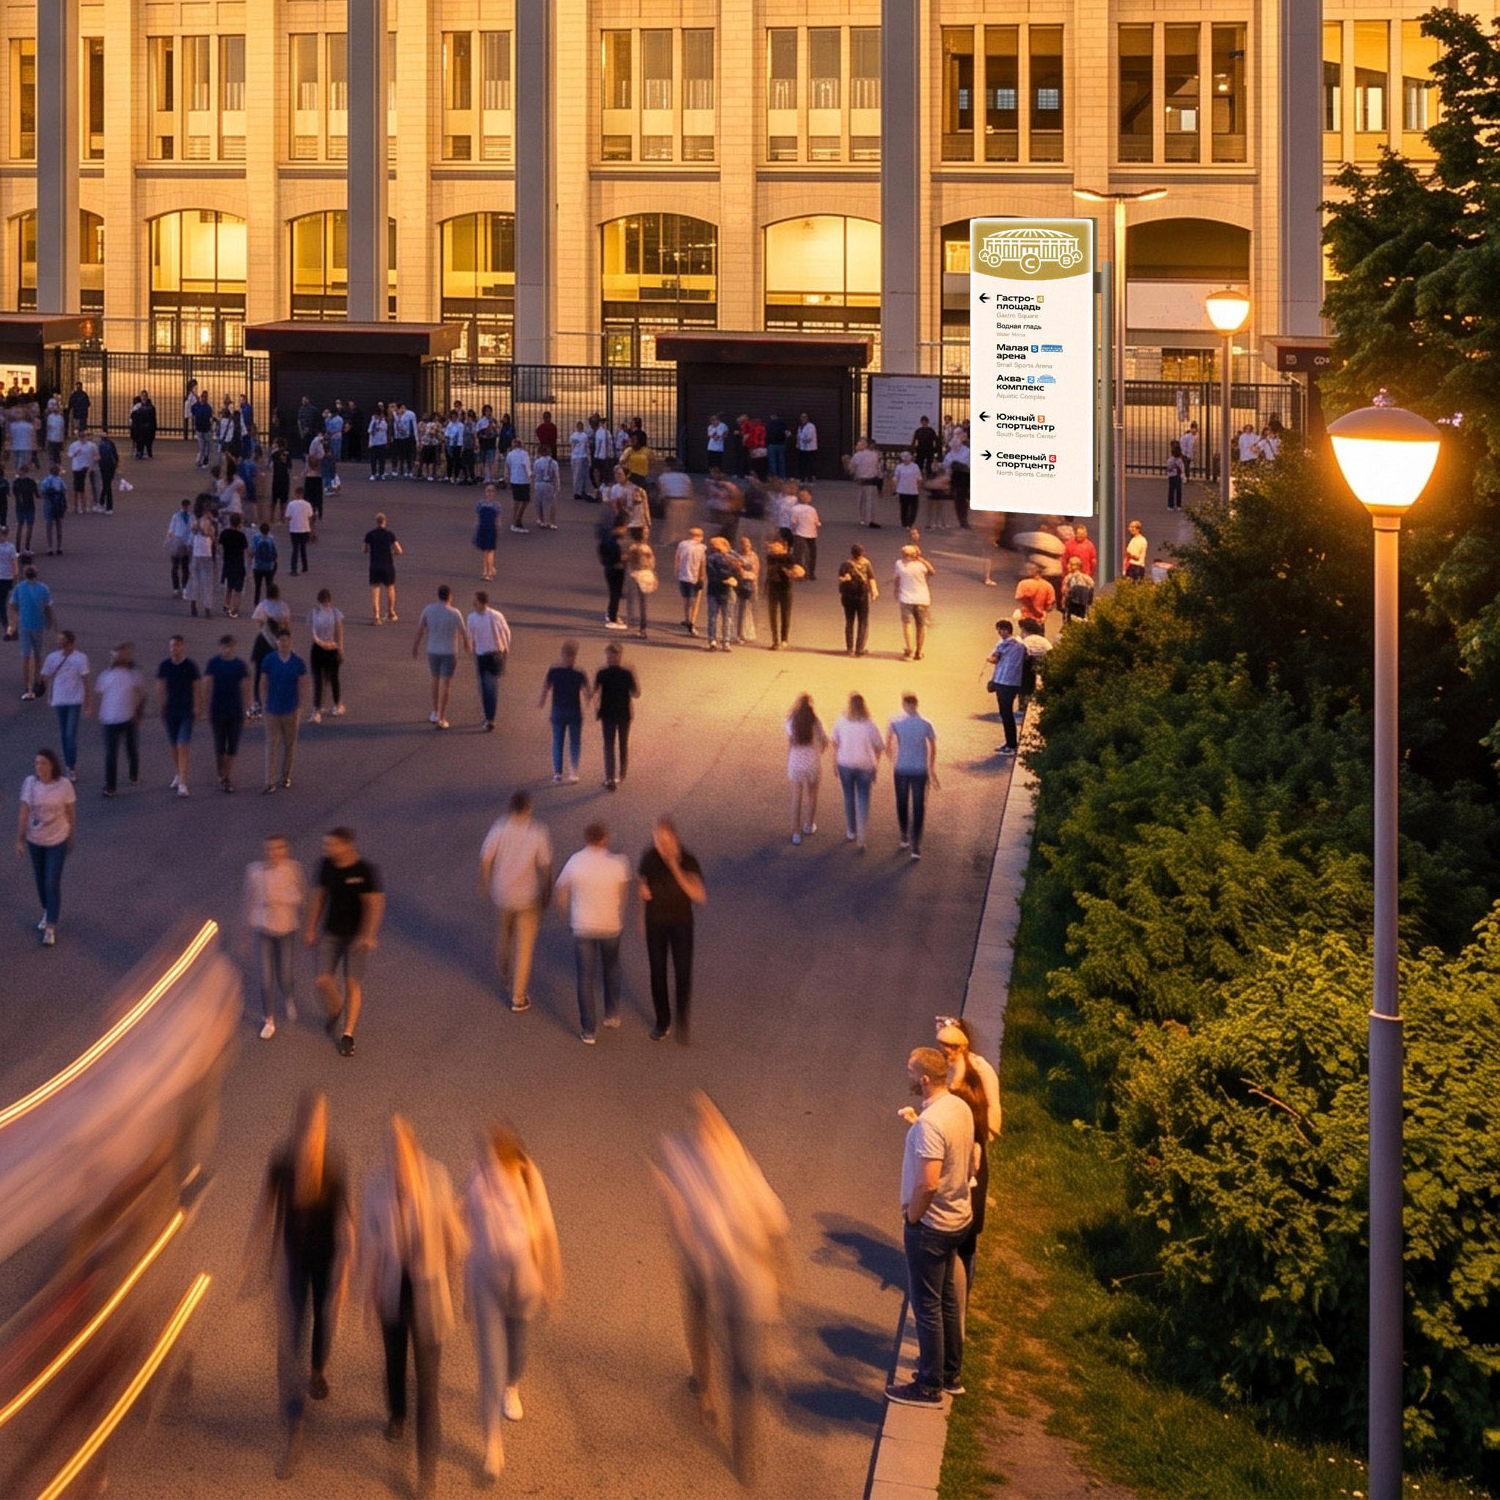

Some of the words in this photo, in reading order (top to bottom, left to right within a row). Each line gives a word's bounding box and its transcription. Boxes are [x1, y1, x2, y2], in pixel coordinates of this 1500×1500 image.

[990, 256, 999, 264] D
[1025, 258, 1035, 268] C
[1062, 256, 1071, 265] B
[996, 294, 1034, 303] Гастро-
[996, 303, 1041, 311] площадь
[996, 322, 1021, 330] Водная
[996, 343, 1029, 352] Малая
[996, 353, 1026, 361] арена
[996, 374, 1025, 382] Аква-
[996, 383, 1045, 392] комплекс
[996, 413, 1035, 422] Южный
[996, 422, 1055, 432] спортцентр
[1015, 431, 1035, 439] Sports
[996, 451, 1047, 461] Северный
[996, 461, 1055, 471] спортцентр
[1015, 470, 1035, 478] Sports
